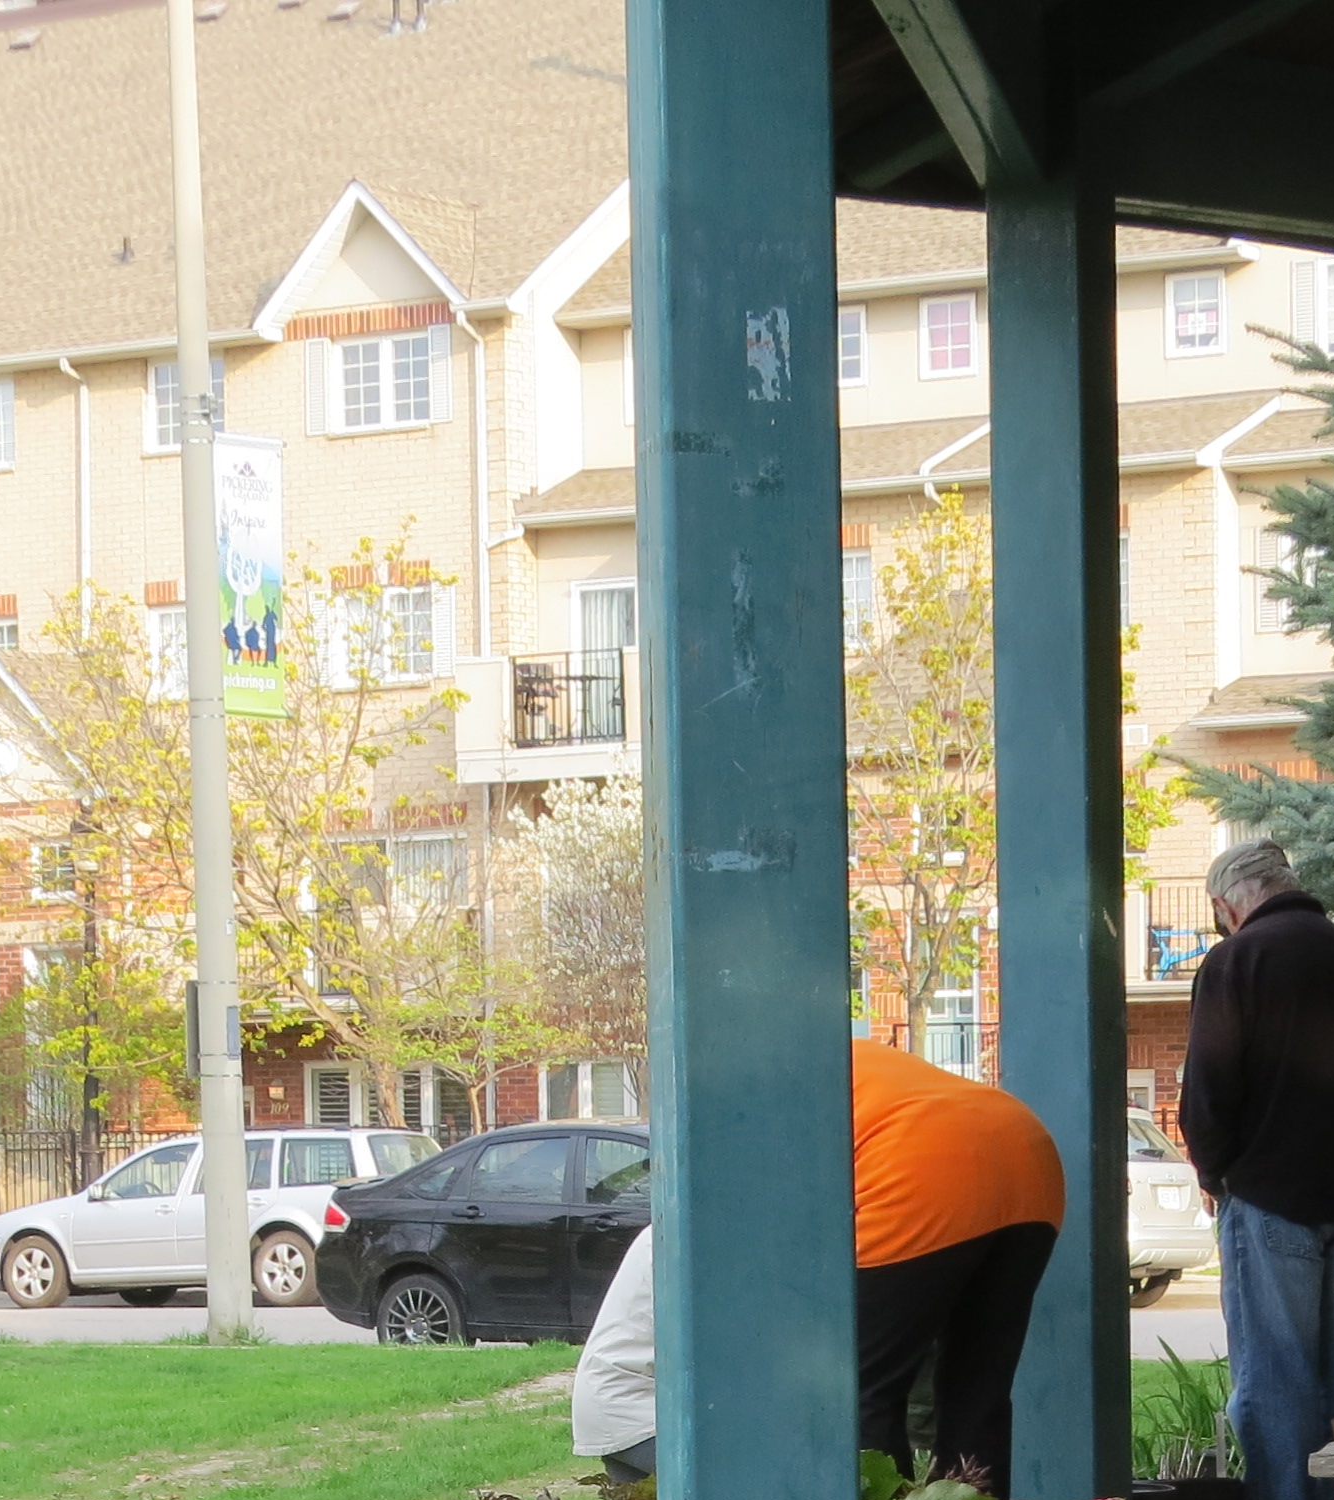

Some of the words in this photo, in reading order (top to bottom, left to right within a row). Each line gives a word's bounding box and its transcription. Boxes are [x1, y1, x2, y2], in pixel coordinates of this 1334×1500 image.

[221, 475, 273, 493] PICKERING
[223, 671, 276, 693] pickering.ca
[270, 1102, 290, 1114] 109
